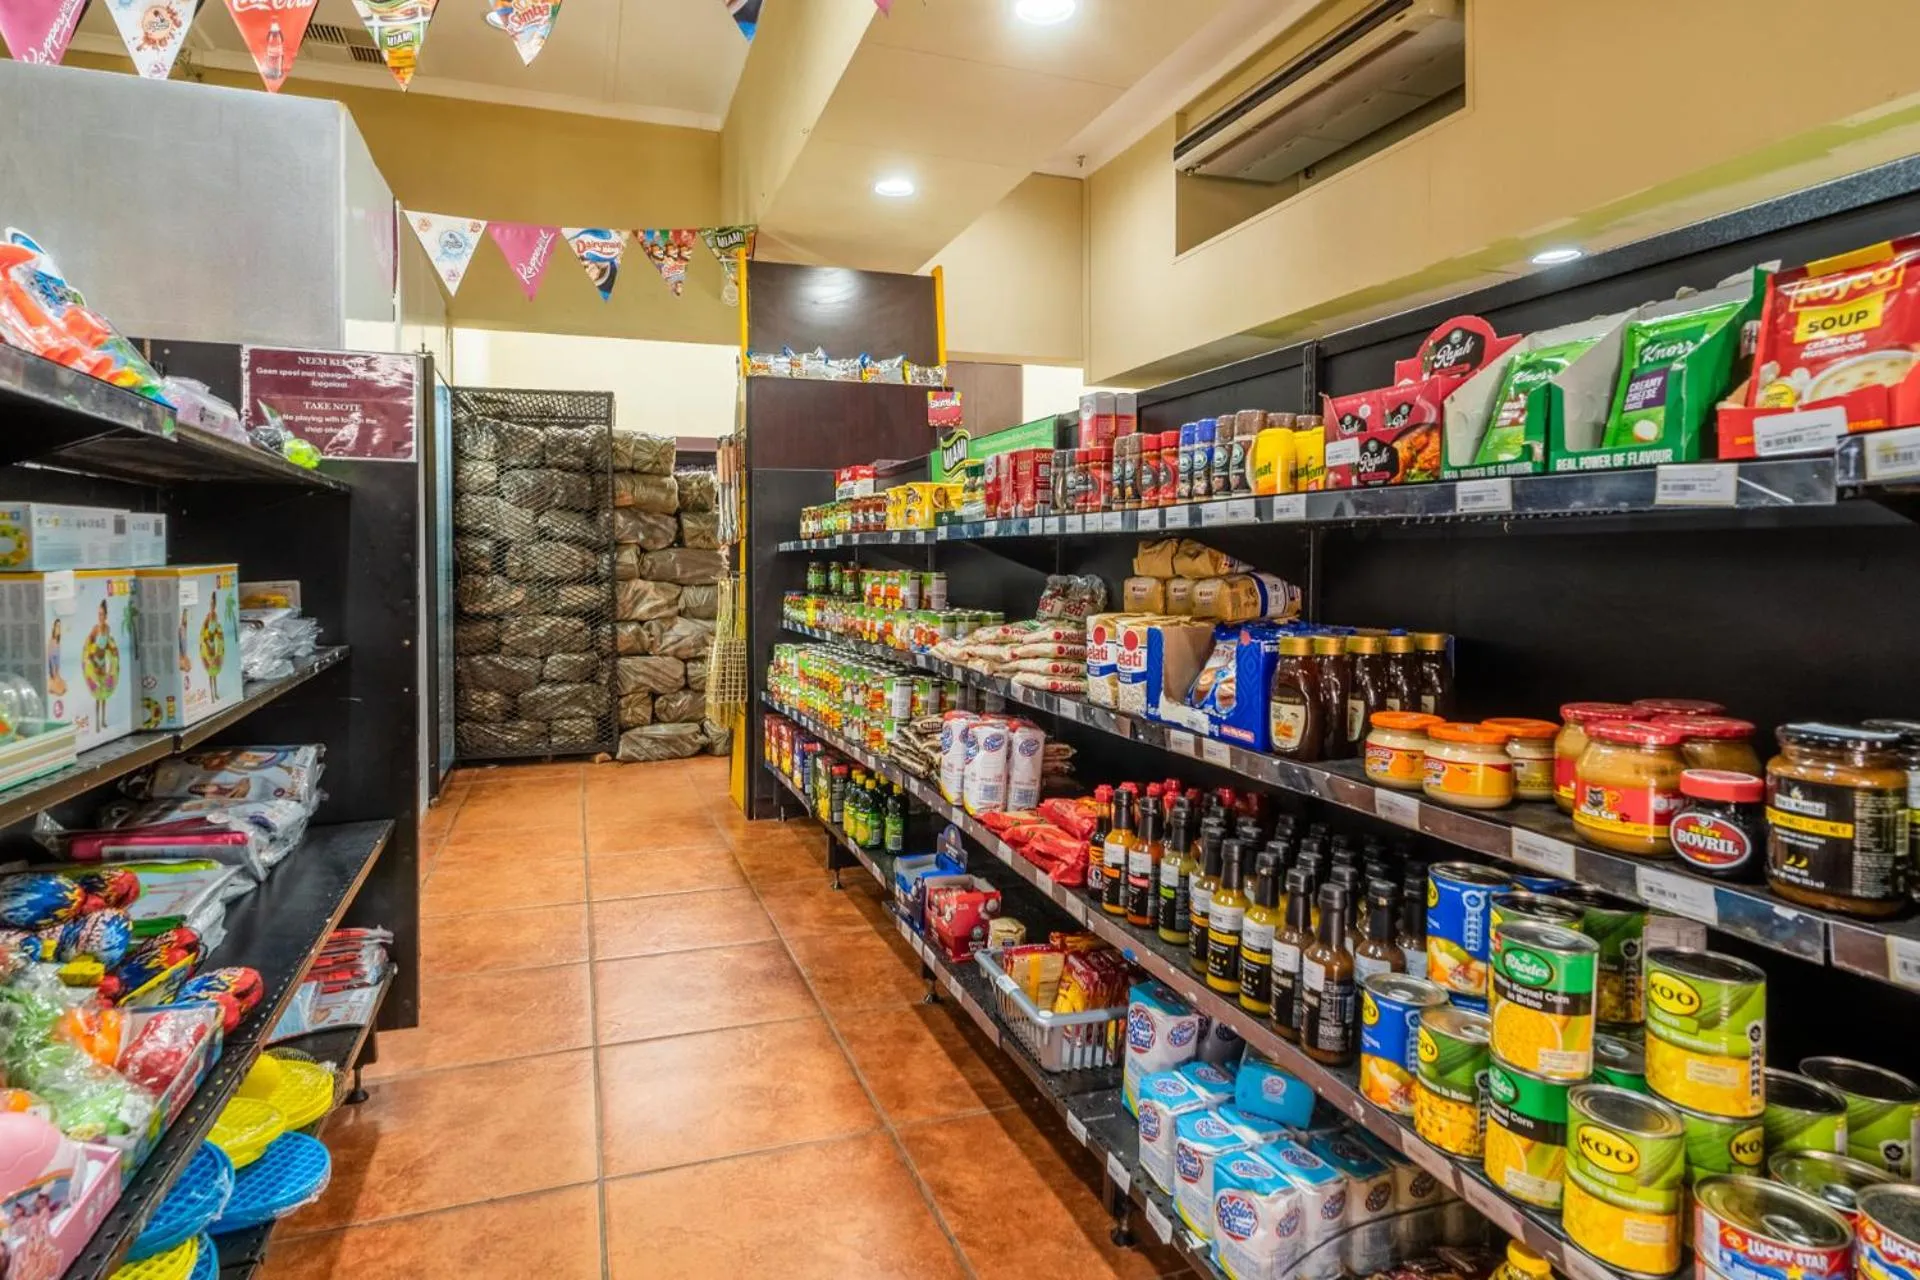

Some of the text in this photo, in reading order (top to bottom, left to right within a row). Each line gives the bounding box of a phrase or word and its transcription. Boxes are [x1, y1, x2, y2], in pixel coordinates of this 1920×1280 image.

[387, 32, 413, 47] MIAMI
[717, 233, 744, 247] MIAMI
[1808, 310, 1869, 333] SOUP
[298, 356, 327, 366] NEEM
[1433, 335, 1475, 369] Rajah
[1641, 339, 1696, 364] Knorr
[1626, 388, 1658, 404] CHEESE
[1629, 376, 1665, 394] CREAMY
[303, 402, 362, 412] TAKE NOTE
[1556, 448, 1673, 471] REAL POWER OF FLAVOUR
[1087, 645, 1109, 661] elati
[1117, 650, 1143, 667] elati
[1677, 828, 1739, 856] BOVRIL
[1505, 952, 1549, 979] Rhodes
[1507, 991, 1543, 1010] in Brine
[1513, 983, 1570, 1005] Kernel Corn
[1650, 981, 1694, 1006] KOO
[1510, 1110, 1534, 1130] Corn
[1581, 1133, 1634, 1164] KOO
[1735, 1141, 1762, 1155] KO
[1219, 1195, 1253, 1218] Golden
[1221, 1212, 1252, 1237] Cloud
[1748, 1238, 1829, 1271] LUCKY STAR
